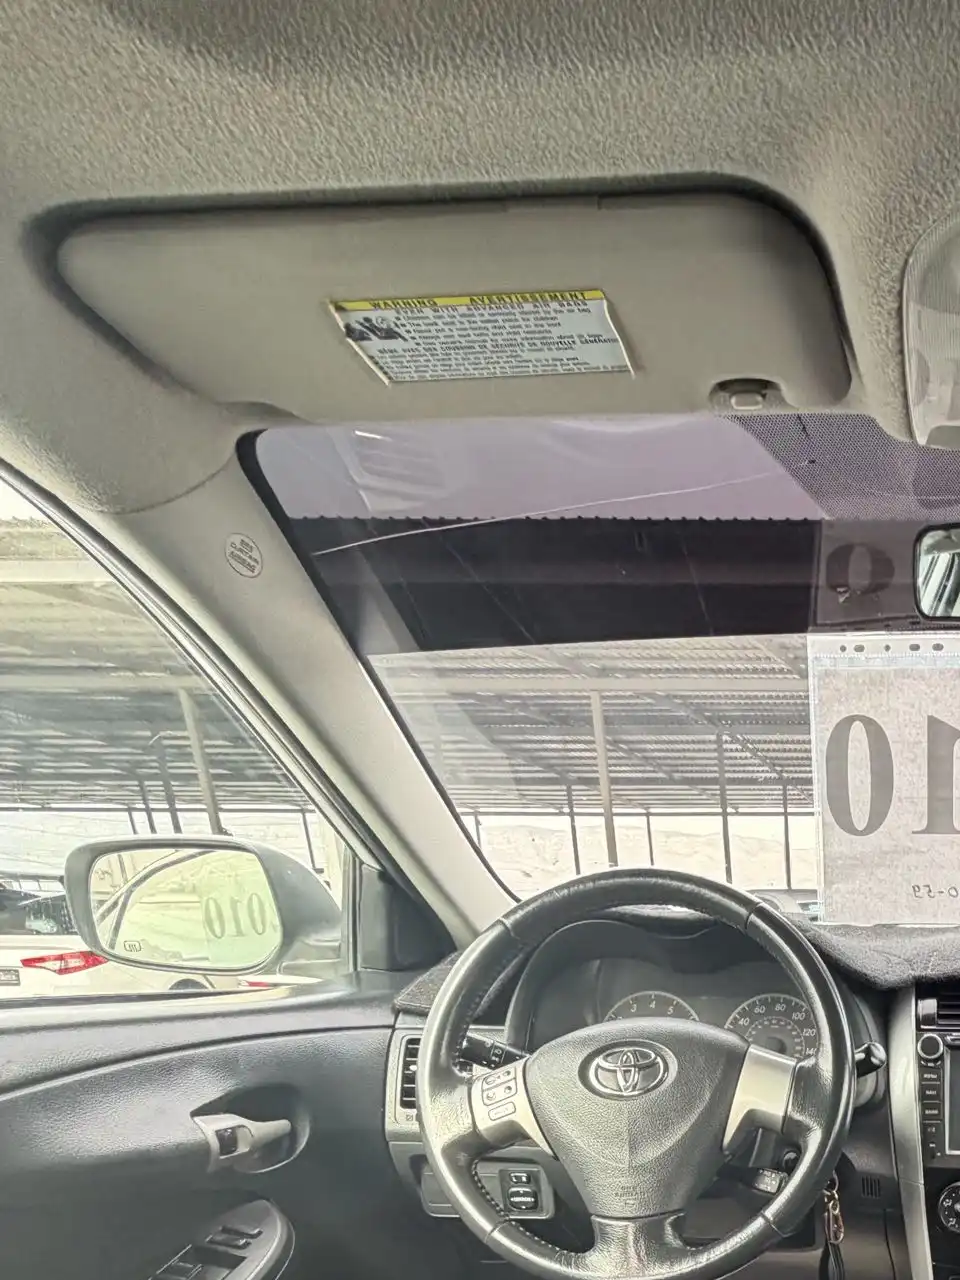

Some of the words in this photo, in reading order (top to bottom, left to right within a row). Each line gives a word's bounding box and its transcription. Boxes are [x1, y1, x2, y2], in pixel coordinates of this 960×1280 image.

[368, 298, 438, 310] WARNING
[631, 1004, 638, 1013] 3
[650, 1000, 656, 1009] 4
[754, 1004, 766, 1014] 60
[774, 1002, 786, 1012] 80
[668, 1006, 675, 1015] 5
[791, 1012, 806, 1021] 100
[738, 1017, 750, 1027] 40
[802, 1028, 816, 1038] 120
